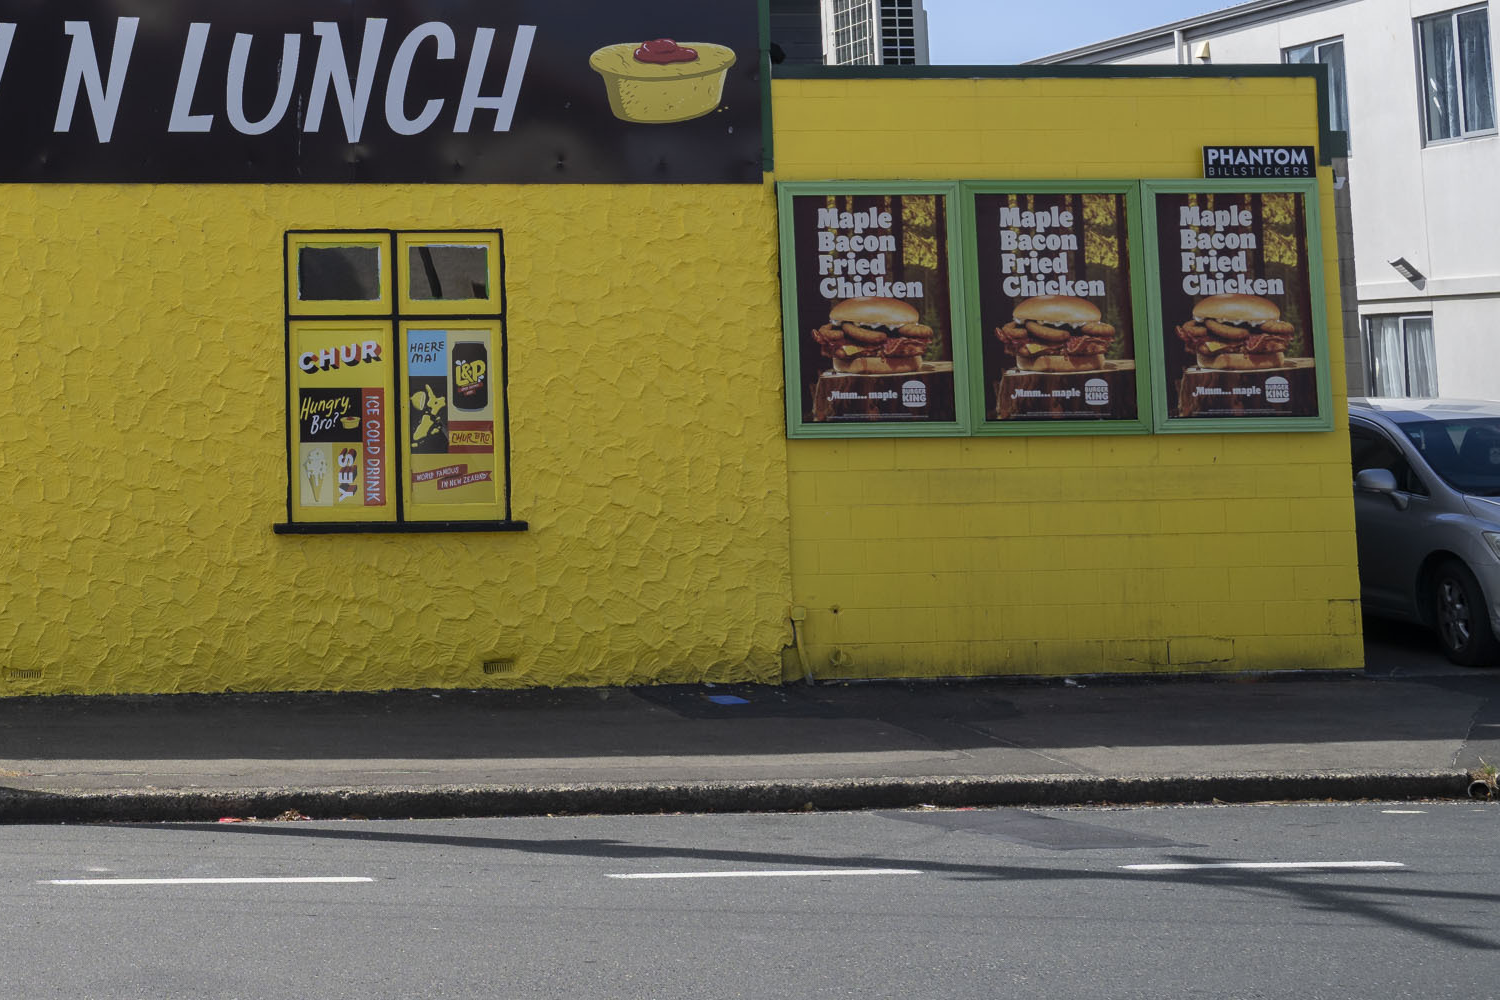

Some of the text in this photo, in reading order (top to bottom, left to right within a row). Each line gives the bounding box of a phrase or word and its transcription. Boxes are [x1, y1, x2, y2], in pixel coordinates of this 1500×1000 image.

[53, 16, 140, 143] N
[168, 17, 537, 143] LUNCH
[1208, 148, 1308, 167] PHANTOM
[1208, 166, 1309, 177] BILLSTICKERS
[817, 207, 893, 235] Maple
[999, 206, 1074, 233] Maple
[1179, 205, 1253, 233] Maple
[818, 231, 896, 253] Bacon
[999, 230, 1078, 251] Bacon
[1180, 229, 1256, 250] Bacon
[819, 252, 887, 276] Fried
[1001, 251, 1068, 275] Fried
[1181, 250, 1247, 274] Fried
[819, 276, 924, 299] Chicken
[1002, 274, 1105, 297] Chicken
[1183, 273, 1285, 296] Chicken
[298, 340, 381, 373] CHUR
[410, 341, 445, 353] HAERE
[411, 353, 437, 364] MAI
[455, 360, 486, 387] L&P
[827, 390, 898, 401] Mmm... maple
[902, 394, 927, 402] KING
[1011, 388, 1081, 399] Mmm... maple
[1085, 392, 1109, 400] KING
[1192, 385, 1261, 397] Mmm... maple
[1265, 390, 1290, 398] KING
[310, 412, 339, 435] Bro?
[365, 396, 381, 502] ICE COLD DRINK
[452, 432, 475, 444] CHUR
[338, 450, 357, 502] YES
[436, 466, 460, 477] FAMOUS
[441, 472, 488, 488] IN NEW ZEALAND
